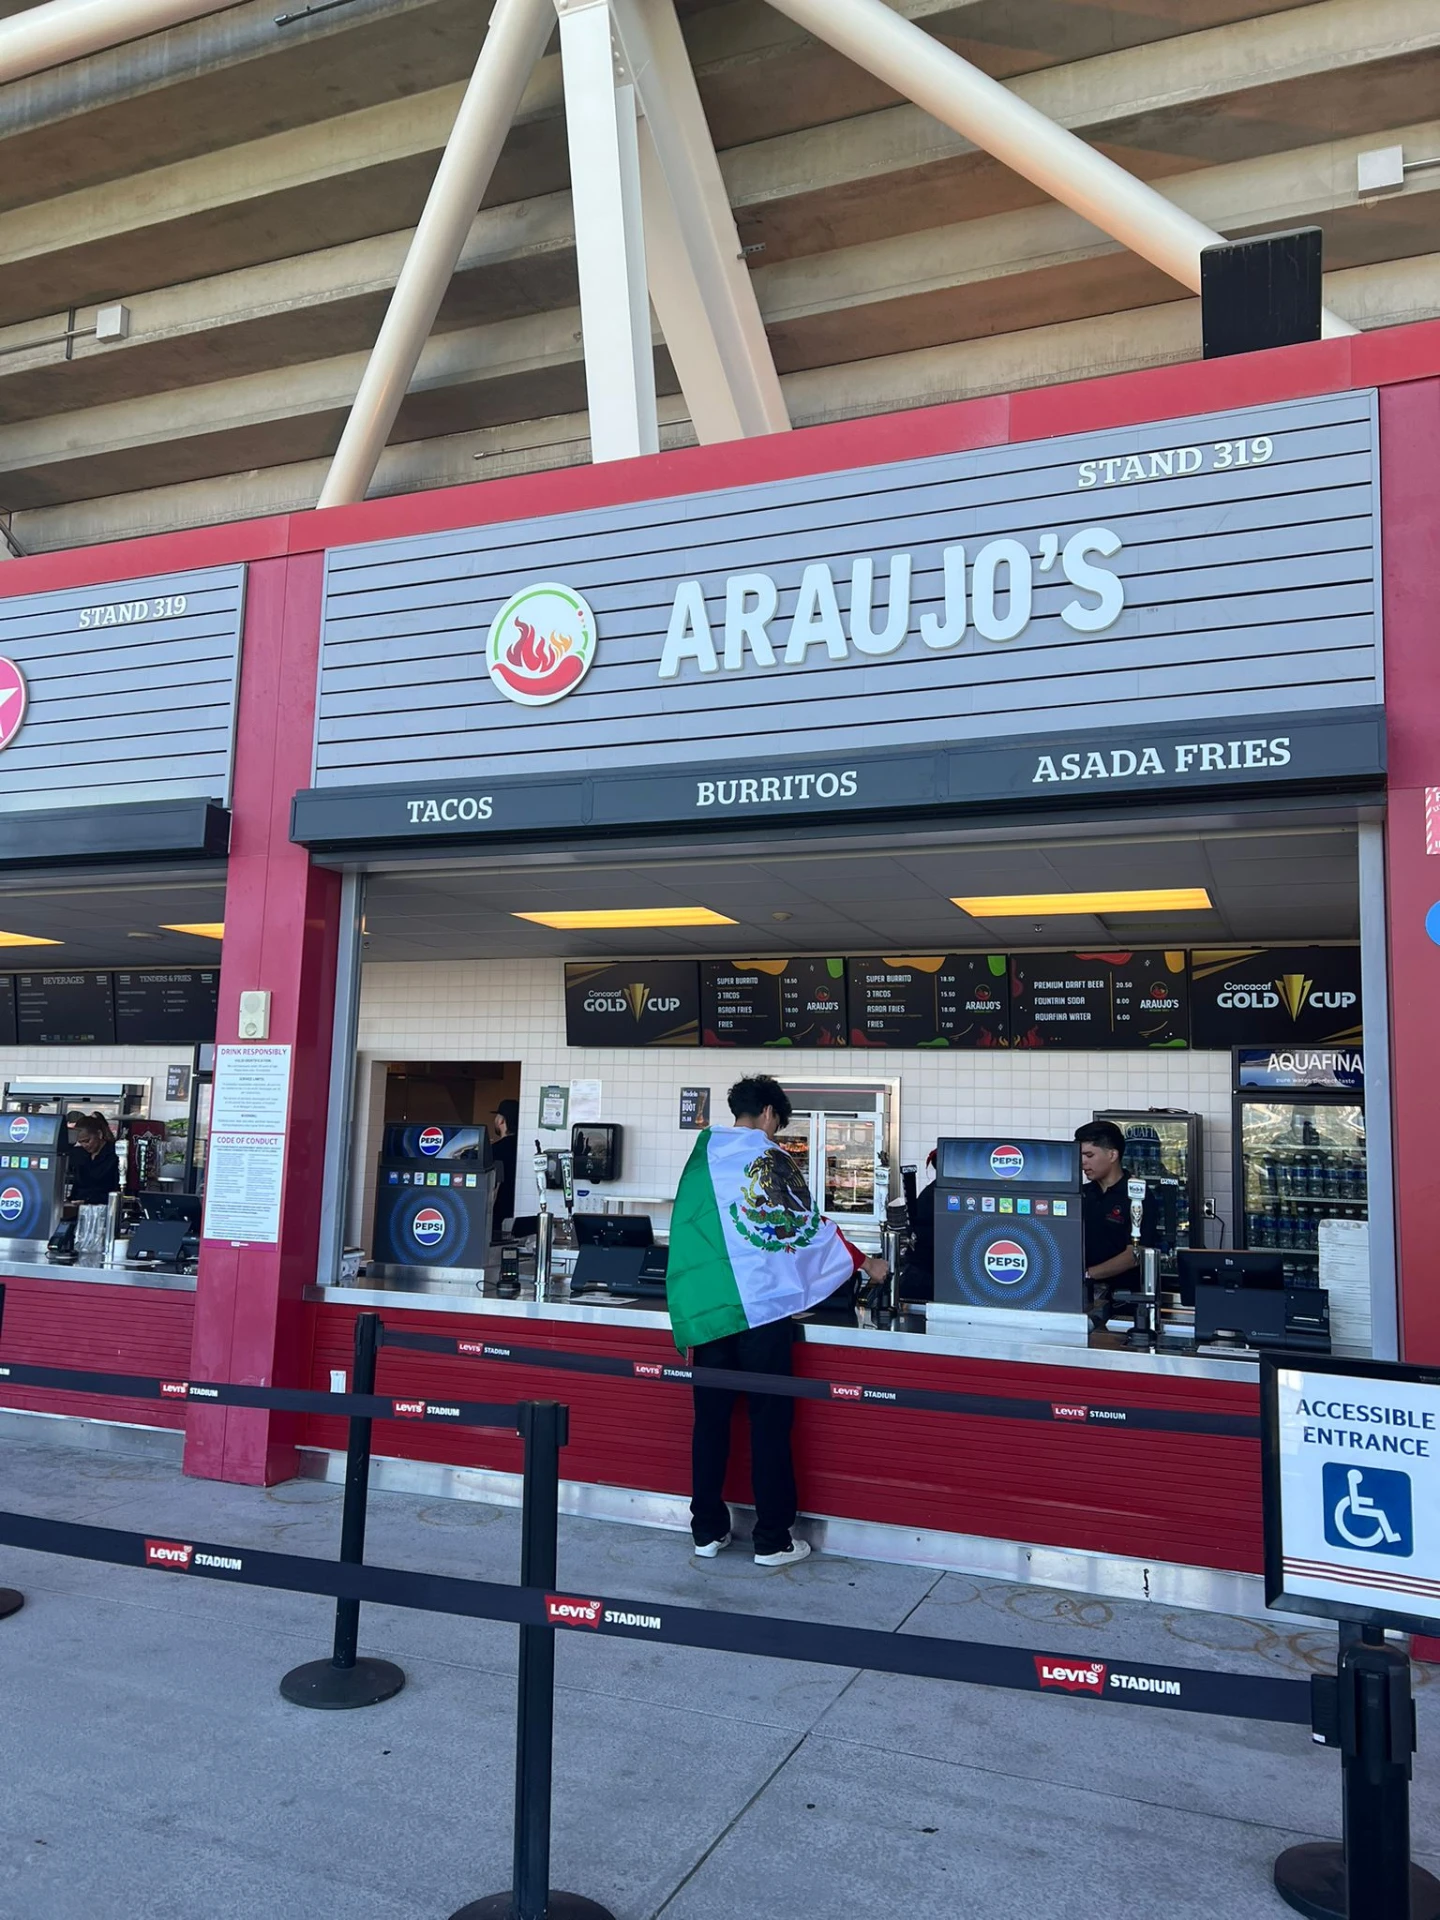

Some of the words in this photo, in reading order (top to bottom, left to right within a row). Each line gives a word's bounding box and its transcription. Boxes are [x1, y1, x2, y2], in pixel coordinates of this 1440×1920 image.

[1077, 446, 1202, 489] STAND
[1211, 435, 1275, 470] 319
[657, 526, 1125, 678] ARAUJO'S
[79, 601, 148, 629] STAND
[152, 596, 187, 618] 319
[1031, 744, 1164, 784] ASADA
[1175, 737, 1292, 772] FRIES
[695, 770, 858, 806] BURRITOS
[407, 796, 494, 823] TACOS
[43, 976, 84, 985] BEVERAGES
[736, 976, 758, 984] BURRITO
[886, 974, 912, 982] BURRITO
[1034, 981, 1064, 989] PREMIUM
[1066, 980, 1086, 989] DRAFT
[1088, 980, 1104, 988] BEER
[1224, 982, 1272, 991] Concacaf
[588, 989, 622, 998] Concacaf
[584, 998, 627, 1012] GOLD
[648, 998, 680, 1012] CUP
[1034, 997, 1066, 1005] FOUNTAIN
[1068, 996, 1086, 1004] SODA
[1140, 1000, 1180, 1008] ARAUJO'S
[1217, 992, 1279, 1008] GOLD
[1309, 992, 1356, 1008] CUP
[806, 1002, 839, 1010] ARAUJO'S
[965, 1001, 1002, 1010] ARAUJO'S
[1034, 1013, 1068, 1021] AQUAFINA
[1069, 1012, 1092, 1020] WATER
[1267, 1053, 1364, 1074] AQUAFINA
[992, 1157, 1022, 1165] PEPSI
[415, 1222, 443, 1232] PEPSI
[988, 1256, 1025, 1268] PEPSI
[484, 1347, 510, 1356] STADIUM
[664, 1369, 692, 1378] STADIUM
[190, 1387, 218, 1397] STADIUM
[864, 1390, 896, 1400] STADIUM
[426, 1406, 460, 1416] STADIUM
[1055, 1407, 1085, 1418] Levi's
[1089, 1410, 1126, 1420] STADIUM
[1296, 1398, 1436, 1430] ACCESSIBLE
[1304, 1426, 1430, 1458] ENTRANCE
[150, 1547, 188, 1562] Levi's
[194, 1553, 242, 1570] STADIUM
[550, 1604, 596, 1620] Levi's
[604, 1610, 661, 1630] STADIUM
[1042, 1666, 1099, 1685] Levi's
[1110, 1674, 1181, 1696] STADIUM
